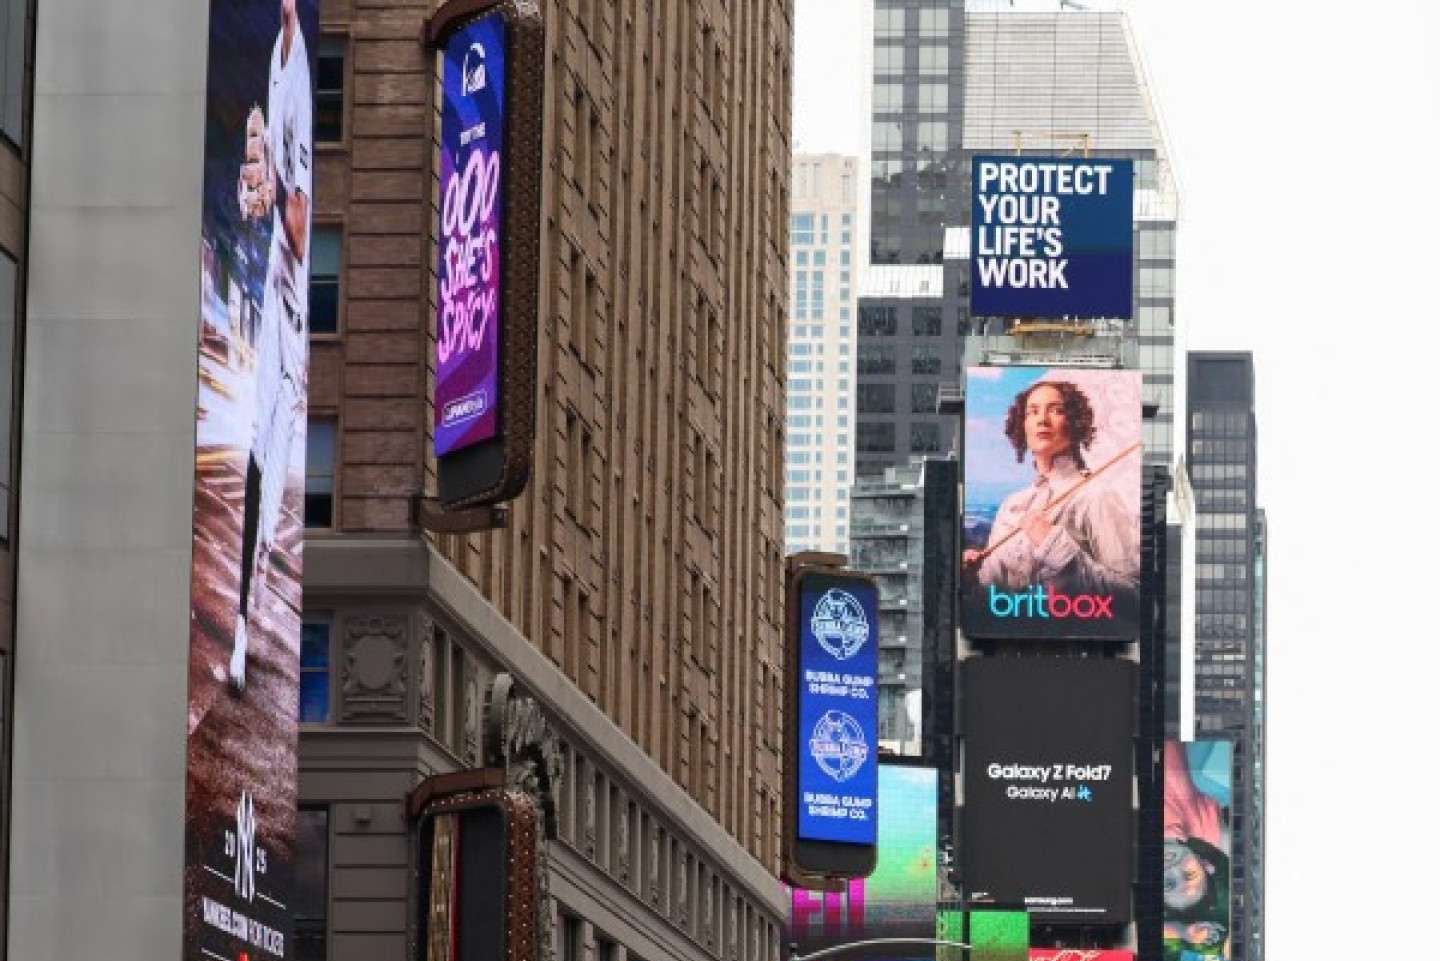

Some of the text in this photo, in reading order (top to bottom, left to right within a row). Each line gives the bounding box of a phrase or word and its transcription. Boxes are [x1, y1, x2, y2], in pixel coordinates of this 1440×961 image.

[979, 162, 1113, 195] PROTECT
[978, 194, 1061, 224] YOUR
[977, 226, 1063, 257] LIFE'S
[976, 258, 1069, 289] WORK
[989, 583, 1113, 618] britbox
[988, 763, 1112, 782] Galaxy Z Fold7
[1006, 785, 1058, 802] Galaxy
